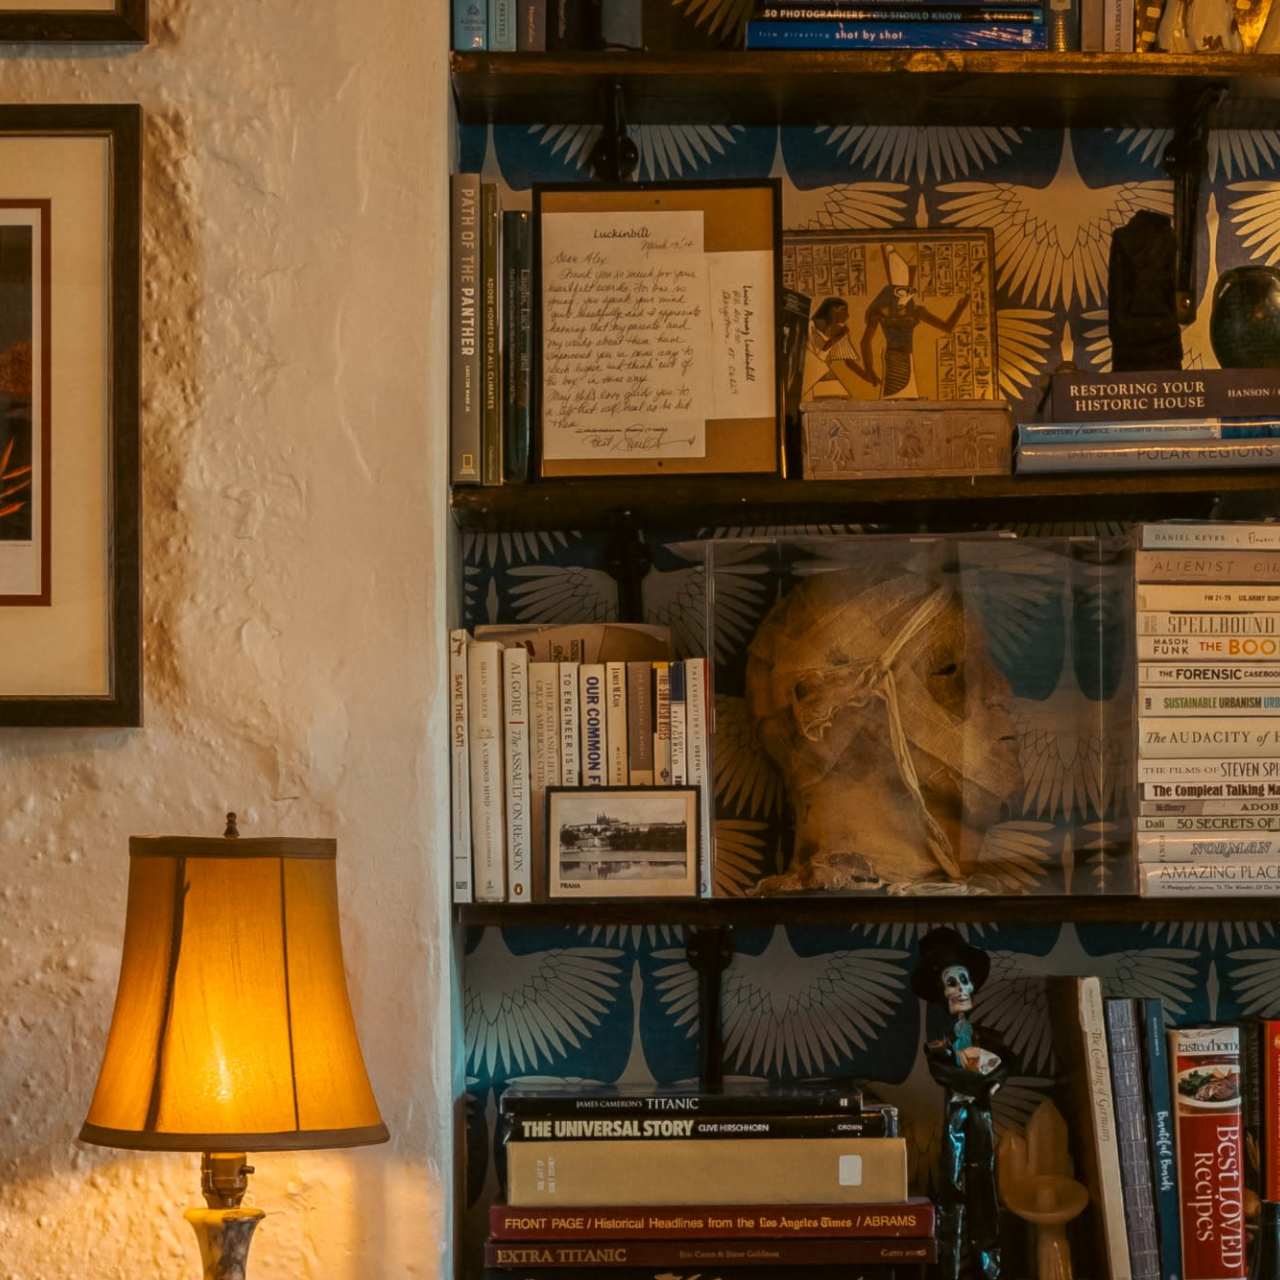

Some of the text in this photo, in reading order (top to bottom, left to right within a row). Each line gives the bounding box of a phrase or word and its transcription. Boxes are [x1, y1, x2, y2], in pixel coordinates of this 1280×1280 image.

[931, 12, 962, 20] KNOW
[879, 29, 903, 40] shot
[461, 188, 475, 356] PATH OF THE PANTHER
[487, 371, 495, 410] CLIMATES
[1070, 380, 1206, 397] RESTORING YOUR
[1227, 387, 1271, 398] HANSON
[1075, 395, 1206, 412] HISTORIC HOUSE
[1198, 445, 1273, 460] REGIONS
[1154, 533, 1190, 542] DANIEL
[1152, 559, 1235, 575] ALIENIST
[1167, 614, 1275, 634] SPELLBOUND
[1153, 638, 1189, 646] MASON
[1199, 641, 1223, 652] THE
[1153, 646, 1189, 656] FUNK
[1176, 668, 1242, 681] FORENSIC
[455, 673, 464, 700] SAVE
[1219, 697, 1262, 709] URBANISM
[563, 690, 573, 749] ENGINEER
[586, 676, 601, 771] OUR COMMON
[1169, 731, 1251, 744] AUDACITY
[511, 680, 524, 873] GORE ASSAULT REASON
[1220, 763, 1260, 777] STEVEN
[1174, 784, 1224, 799] Compleat
[1225, 783, 1266, 799] Talking
[1196, 817, 1255, 829] SECRETS
[1189, 840, 1272, 857] NORMAN
[1159, 864, 1236, 881] AMAZING
[646, 1097, 700, 1111] TITANIC
[521, 1118, 694, 1138] THE UNIVERSAL STORY
[1155, 1110, 1173, 1158] Beautiful
[1186, 1151, 1215, 1243] Recipes
[504, 1215, 917, 1231] FRONT PAGE Historical Headlines from Angeles Times ABRAMS
[1218, 1183, 1243, 1269] LOVED
[495, 1247, 628, 1264] EXTRA TITANIC
